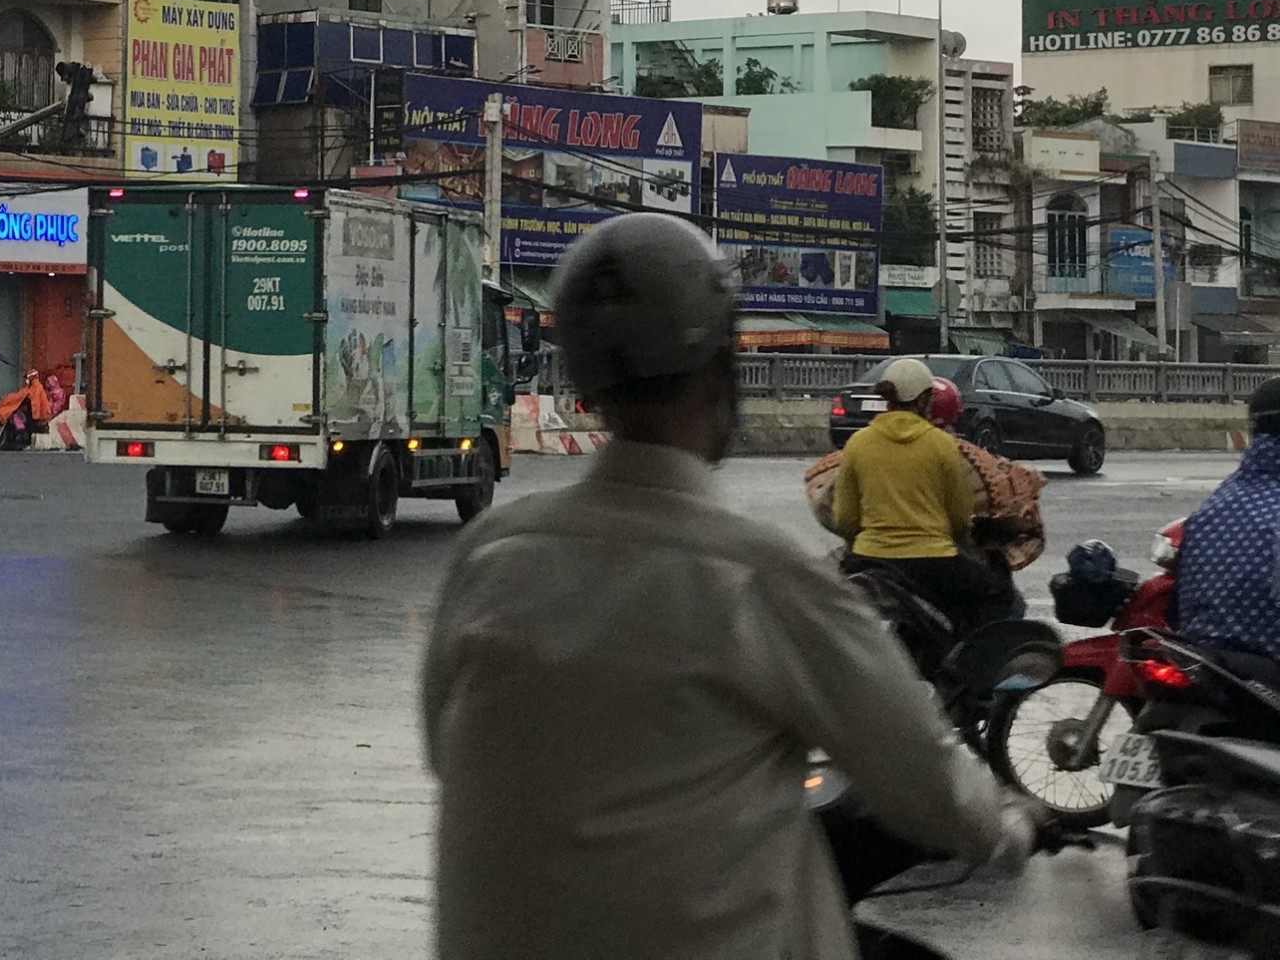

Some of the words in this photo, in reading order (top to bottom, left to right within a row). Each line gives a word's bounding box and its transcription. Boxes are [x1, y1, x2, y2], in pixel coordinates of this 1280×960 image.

[162, 2, 183, 25] MÁY
[187, 4, 205, 27] XÂY
[208, 9, 235, 33] DỰNG
[1047, 11, 1081, 30] IN
[1029, 31, 1133, 51] HOTLINE:
[1137, 28, 1191, 46] 0777
[1196, 26, 1225, 44] 86
[1232, 24, 1261, 41] 86
[132, 39, 168, 80] PHAN
[172, 42, 196, 83] GIA
[130, 90, 145, 108] MUA
[166, 89, 180, 111] SỬA
[204, 96, 218, 114] CHO
[219, 96, 235, 116] THUÊ
[411, 106, 434, 132] NỘI
[567, 108, 642, 150] LONG
[786, 163, 831, 192] ĐĂNG
[835, 171, 878, 197] LONG
[35, 213, 79, 247] PHỤC
[242, 226, 285, 237] Hotline
[231, 239, 308, 252] 1900.8095
[253, 277, 281, 294] 29KT
[247, 295, 285, 311] 007.91
